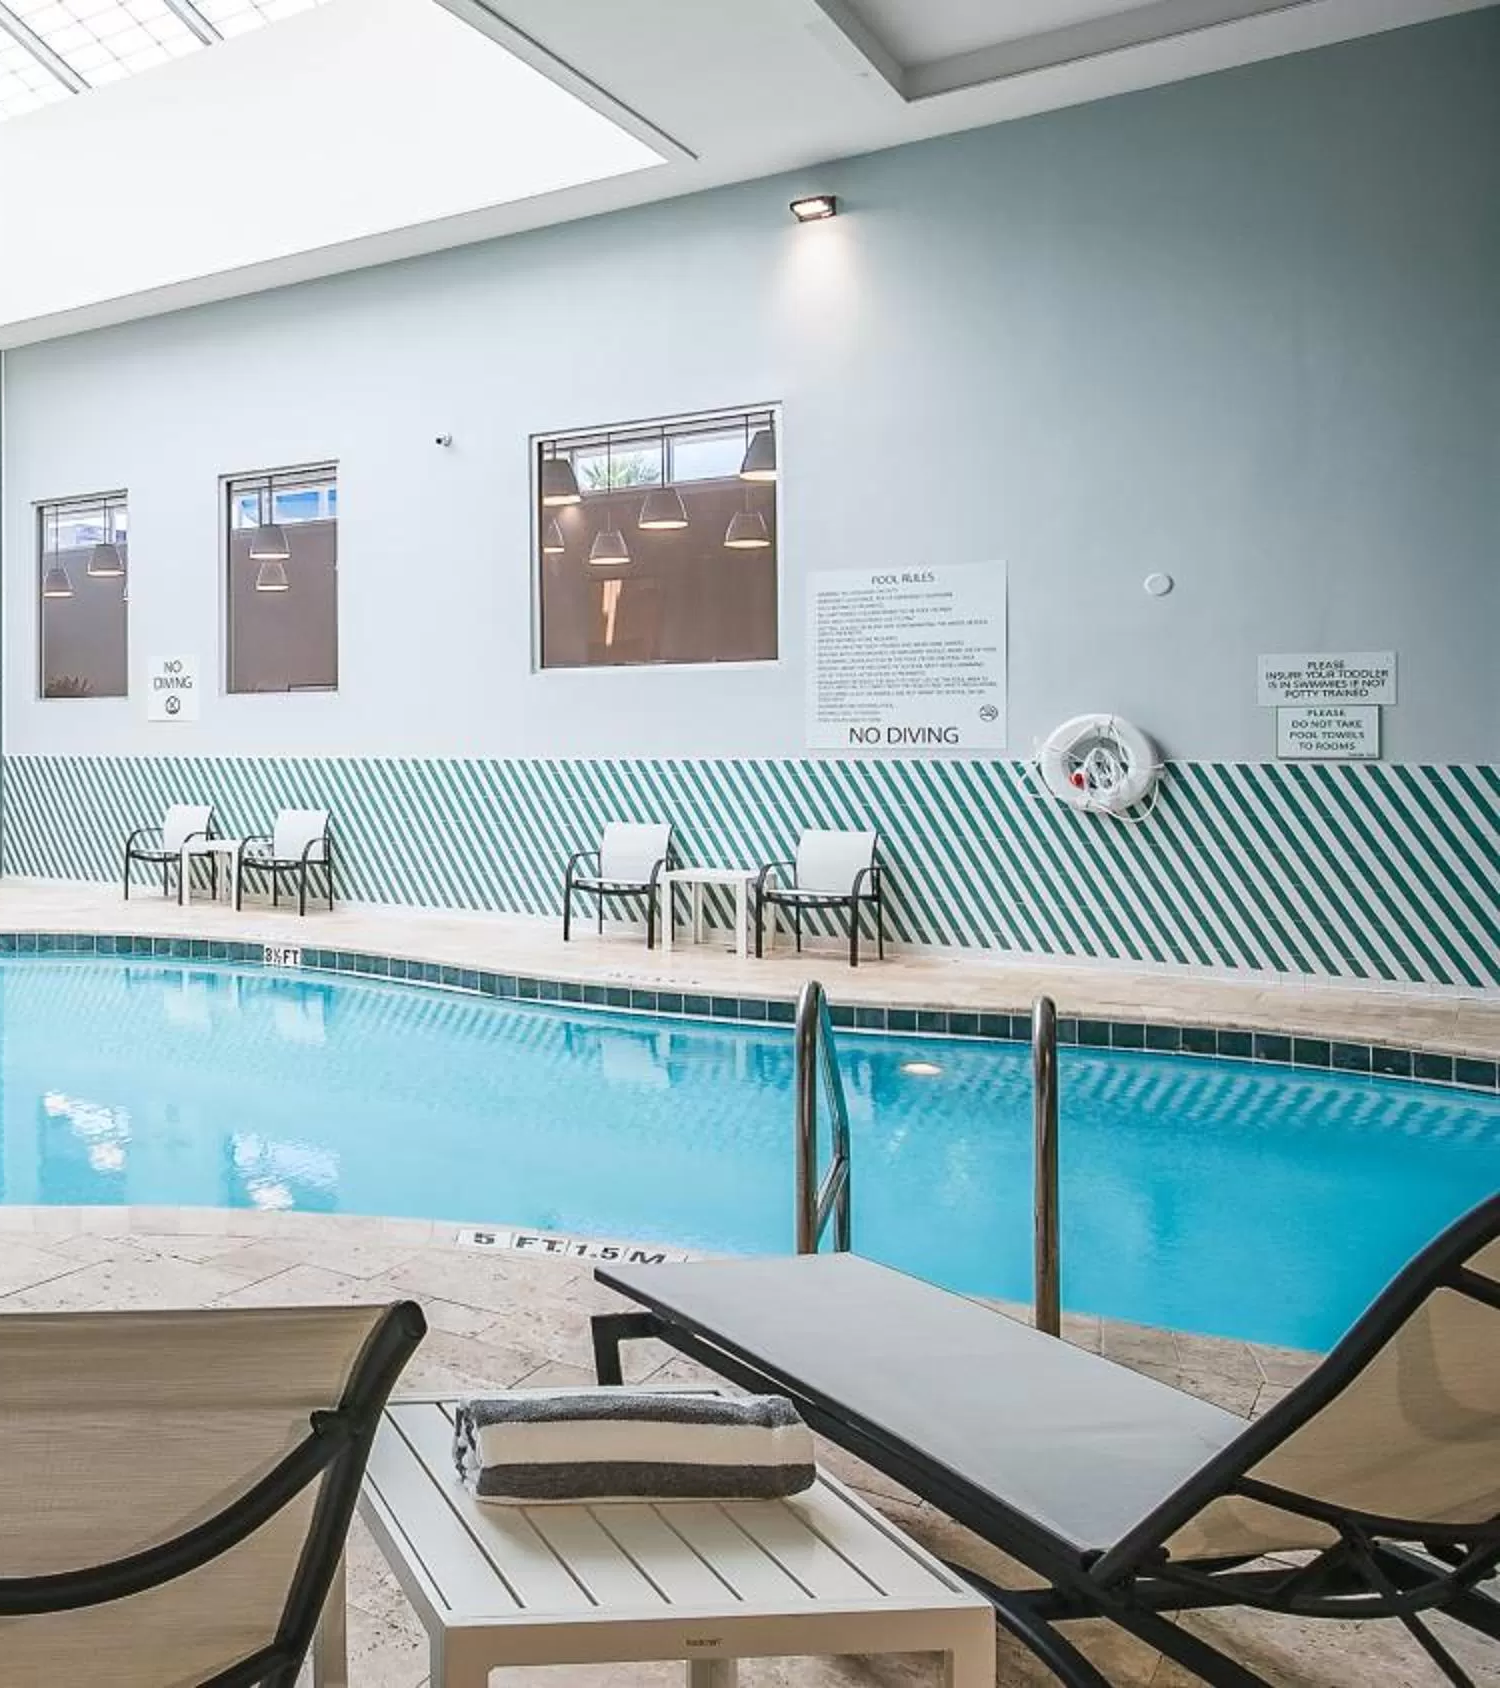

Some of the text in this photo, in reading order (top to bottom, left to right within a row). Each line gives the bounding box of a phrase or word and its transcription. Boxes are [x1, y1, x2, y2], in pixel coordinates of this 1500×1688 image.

[871, 572, 935, 585] POOL RULES
[163, 659, 183, 673] NO
[1307, 660, 1345, 670] PLEASE
[1265, 669, 1389, 680] INSURE YOUR TODDLER
[153, 676, 193, 690] DIVING
[1268, 681, 1277, 689] IS
[1280, 680, 1291, 689] IN
[1350, 680, 1359, 688] IF
[1361, 679, 1386, 688] NOT
[1285, 689, 1369, 699] POTTY TRAINED
[1307, 709, 1345, 717] PLEASE
[1291, 720, 1363, 728] DO NOT TAKE
[849, 727, 959, 744] NO DIVING
[1289, 731, 1365, 739] POOL TOWELS
[1299, 741, 1356, 750] TO ROOMS
[283, 949, 299, 964] FT
[474, 1232, 496, 1245] 5
[576, 1245, 620, 1260] 1.5
[628, 1251, 667, 1264] M
